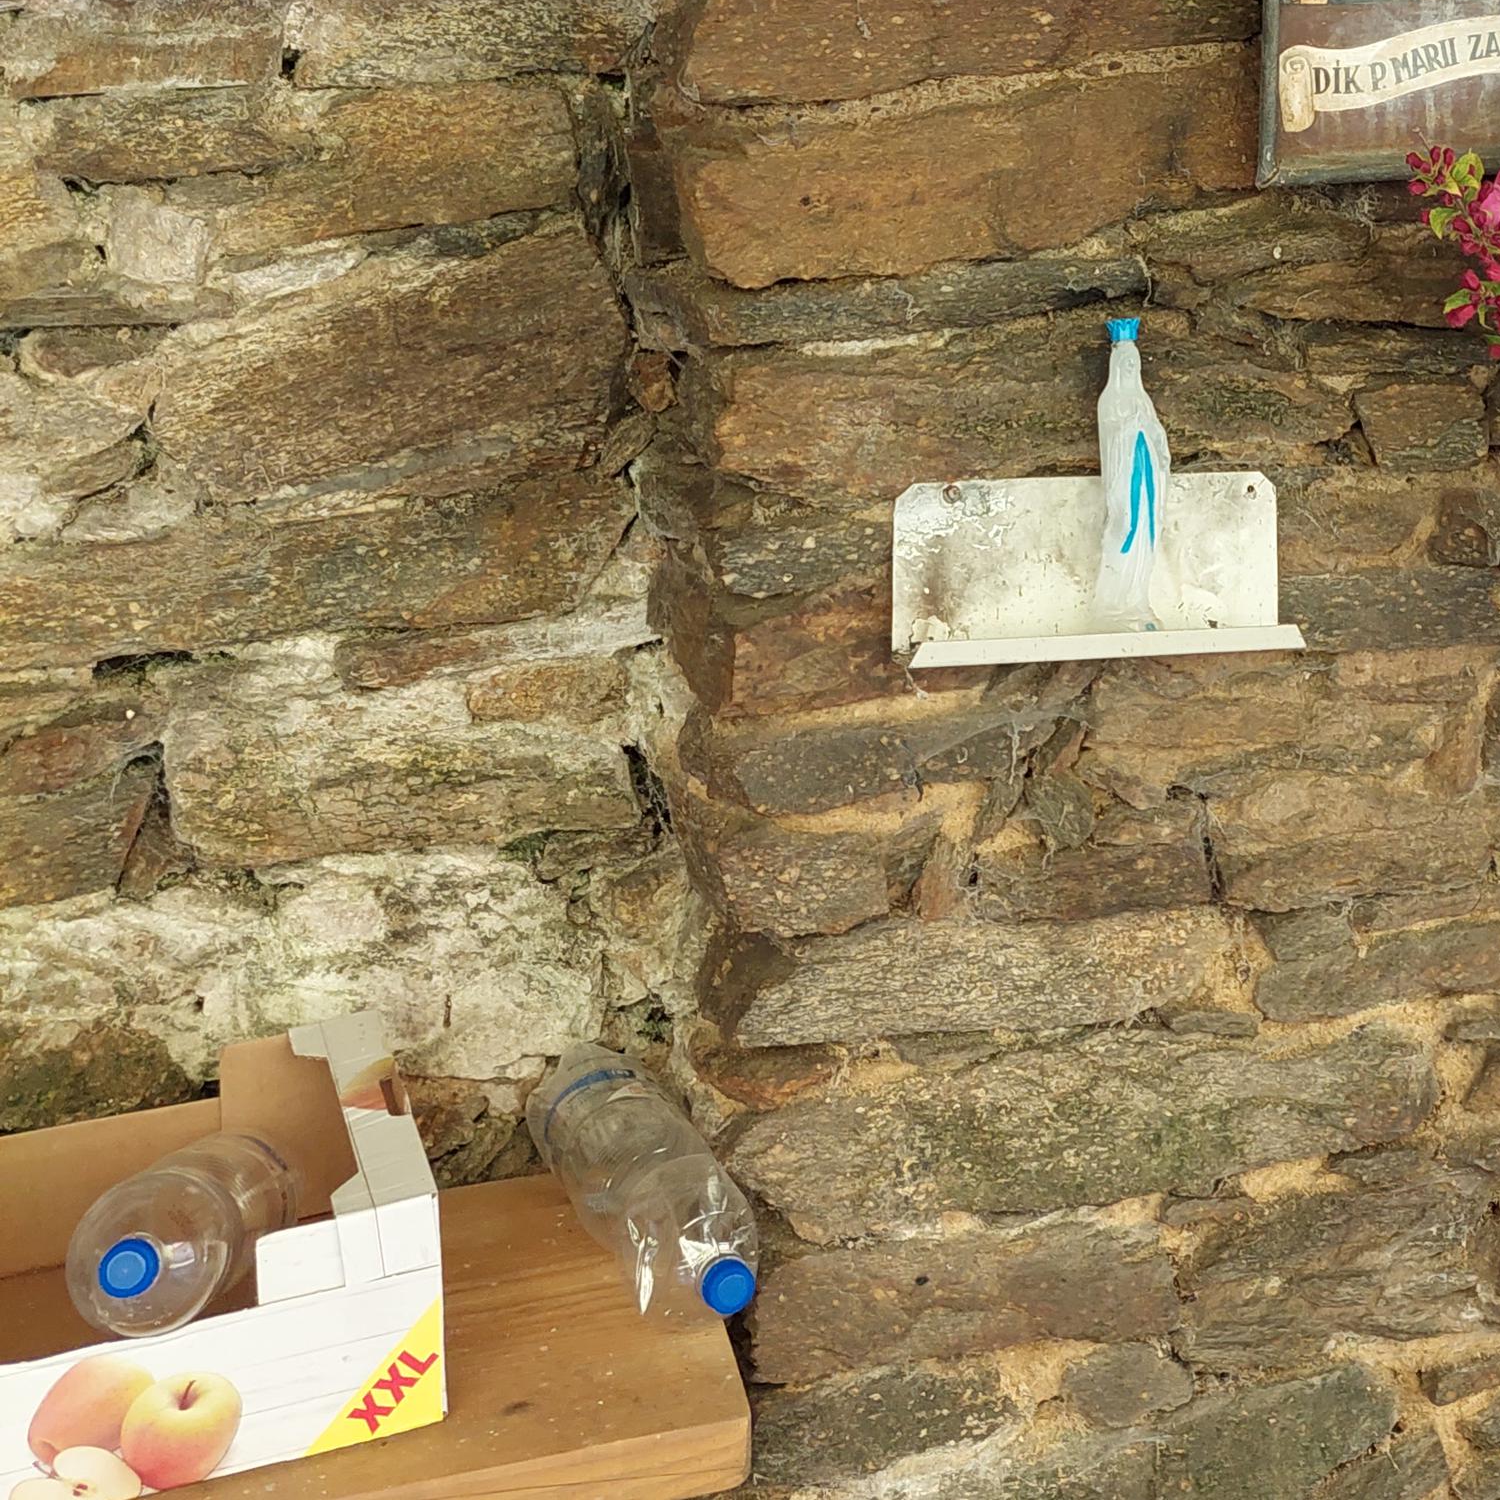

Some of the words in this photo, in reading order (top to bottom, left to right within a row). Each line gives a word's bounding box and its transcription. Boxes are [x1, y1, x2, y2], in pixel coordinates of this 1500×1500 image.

[1313, 59, 1364, 95] DÍK
[1389, 37, 1460, 85] MARII
[347, 1349, 439, 1435] XXL
